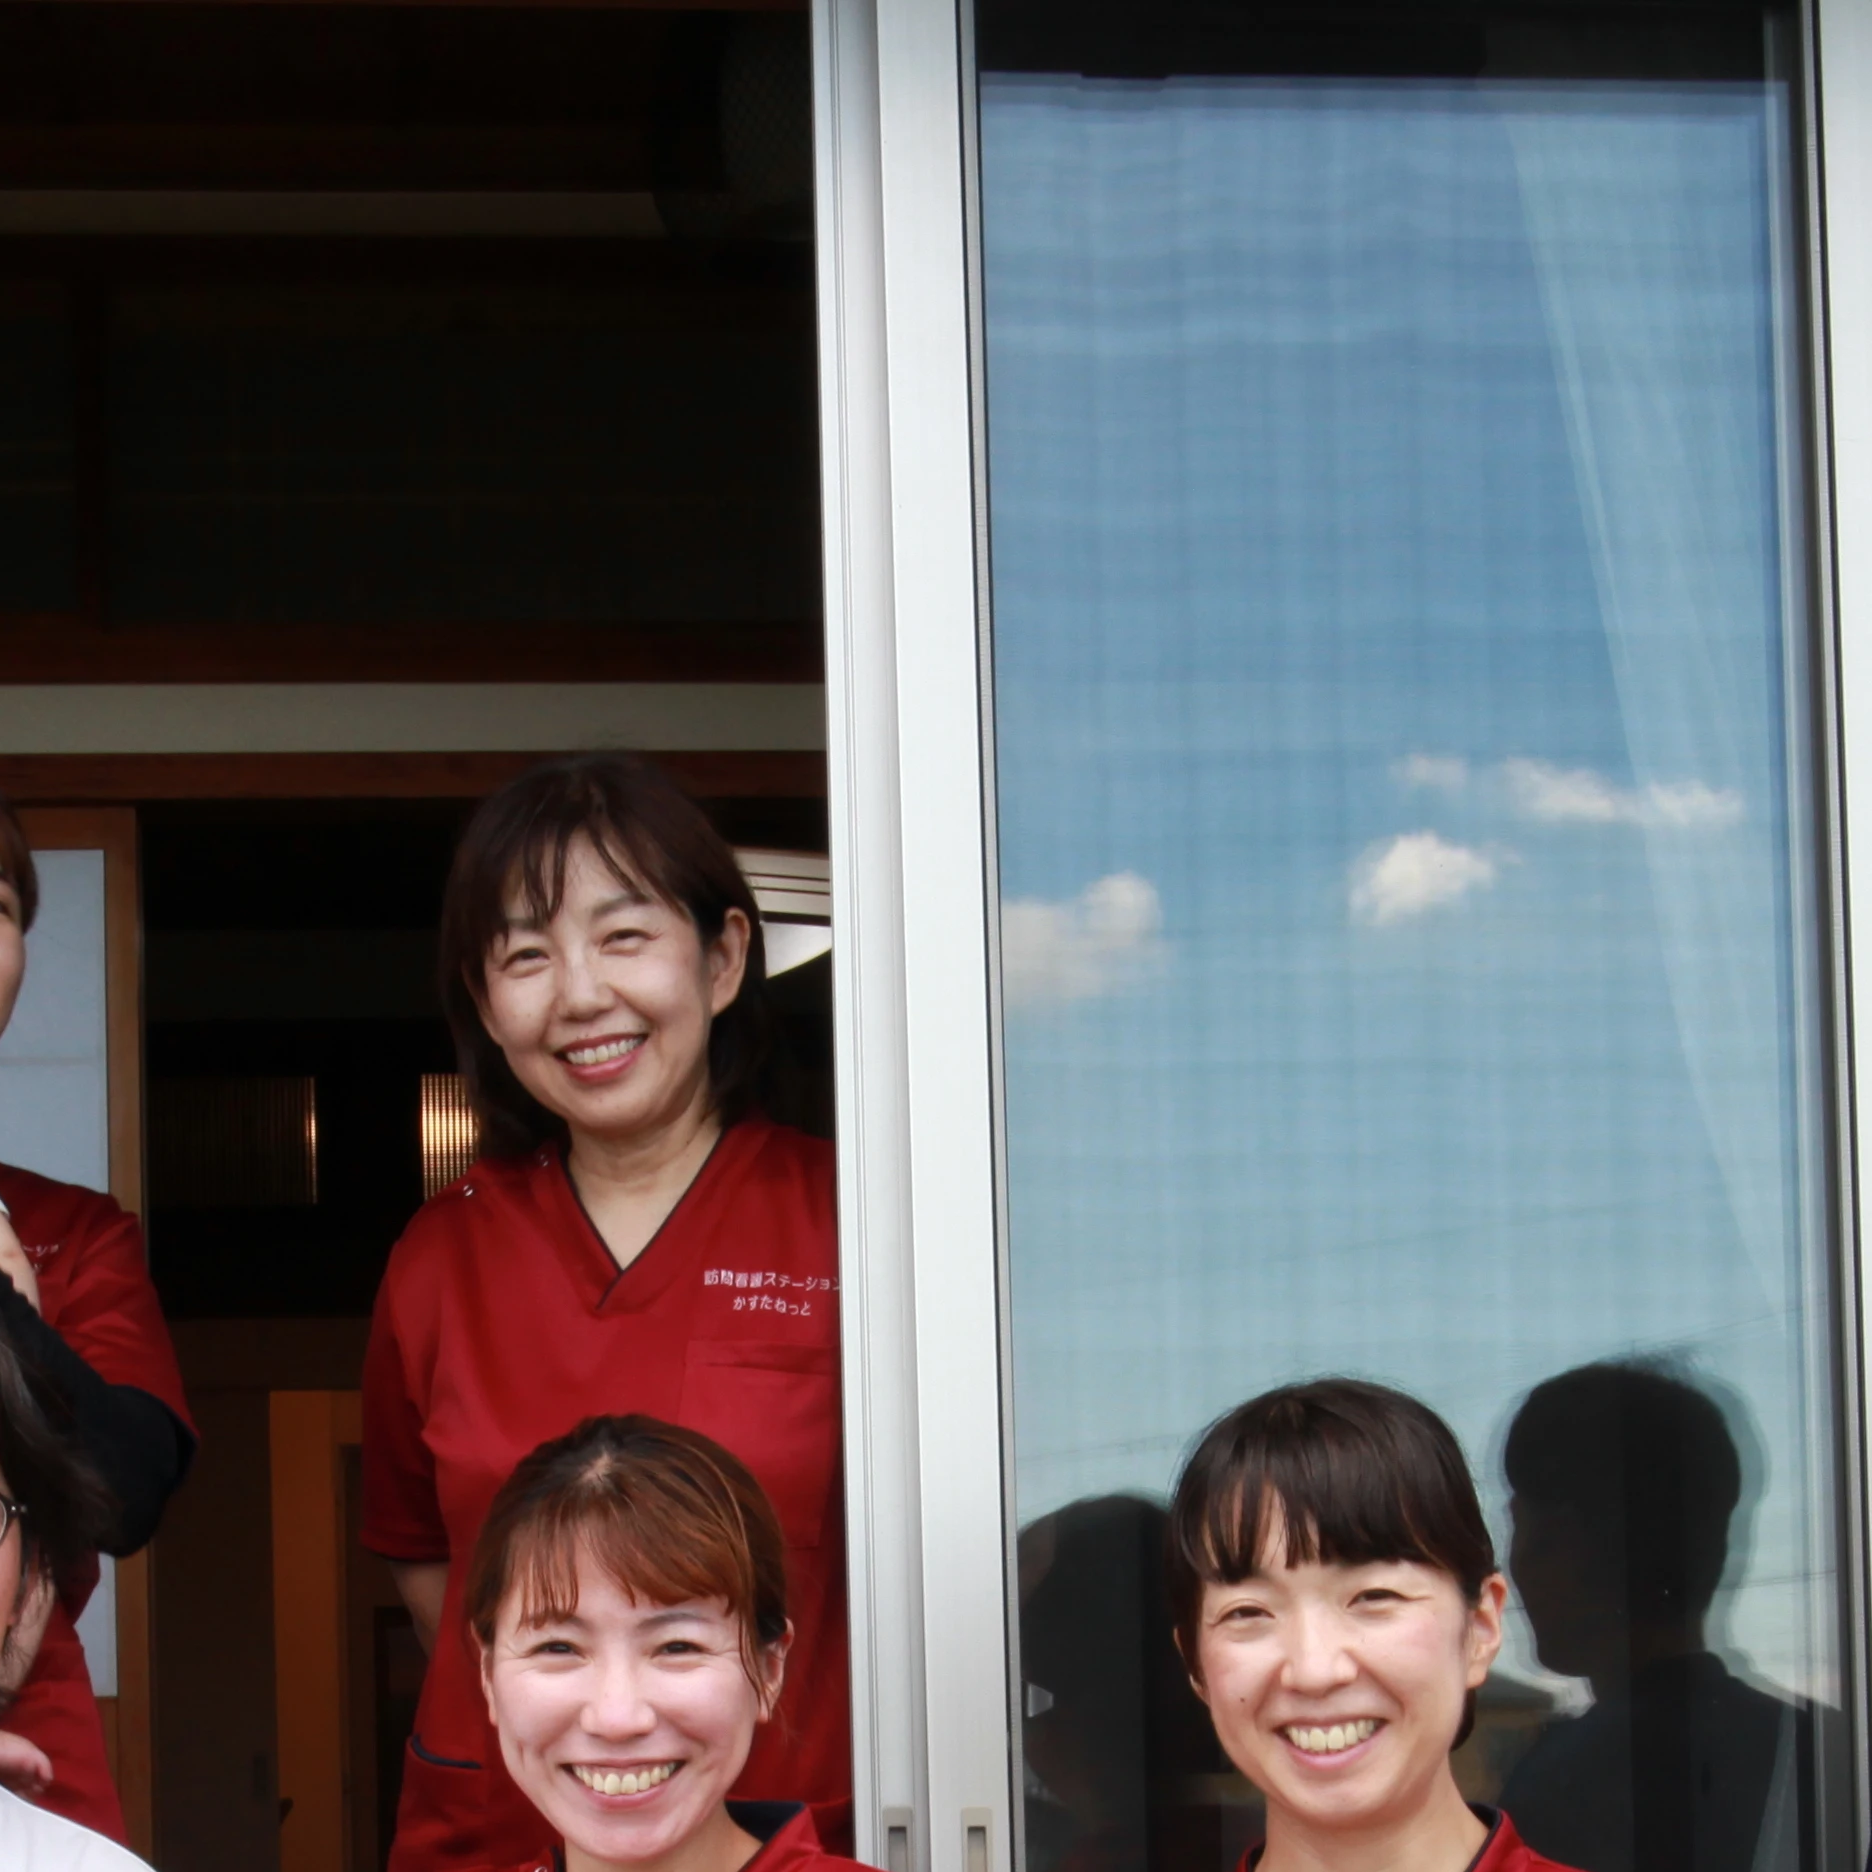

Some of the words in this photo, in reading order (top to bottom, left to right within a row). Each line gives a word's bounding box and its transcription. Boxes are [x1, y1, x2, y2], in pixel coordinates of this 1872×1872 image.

[733, 1295, 811, 1316] かすたねっと
